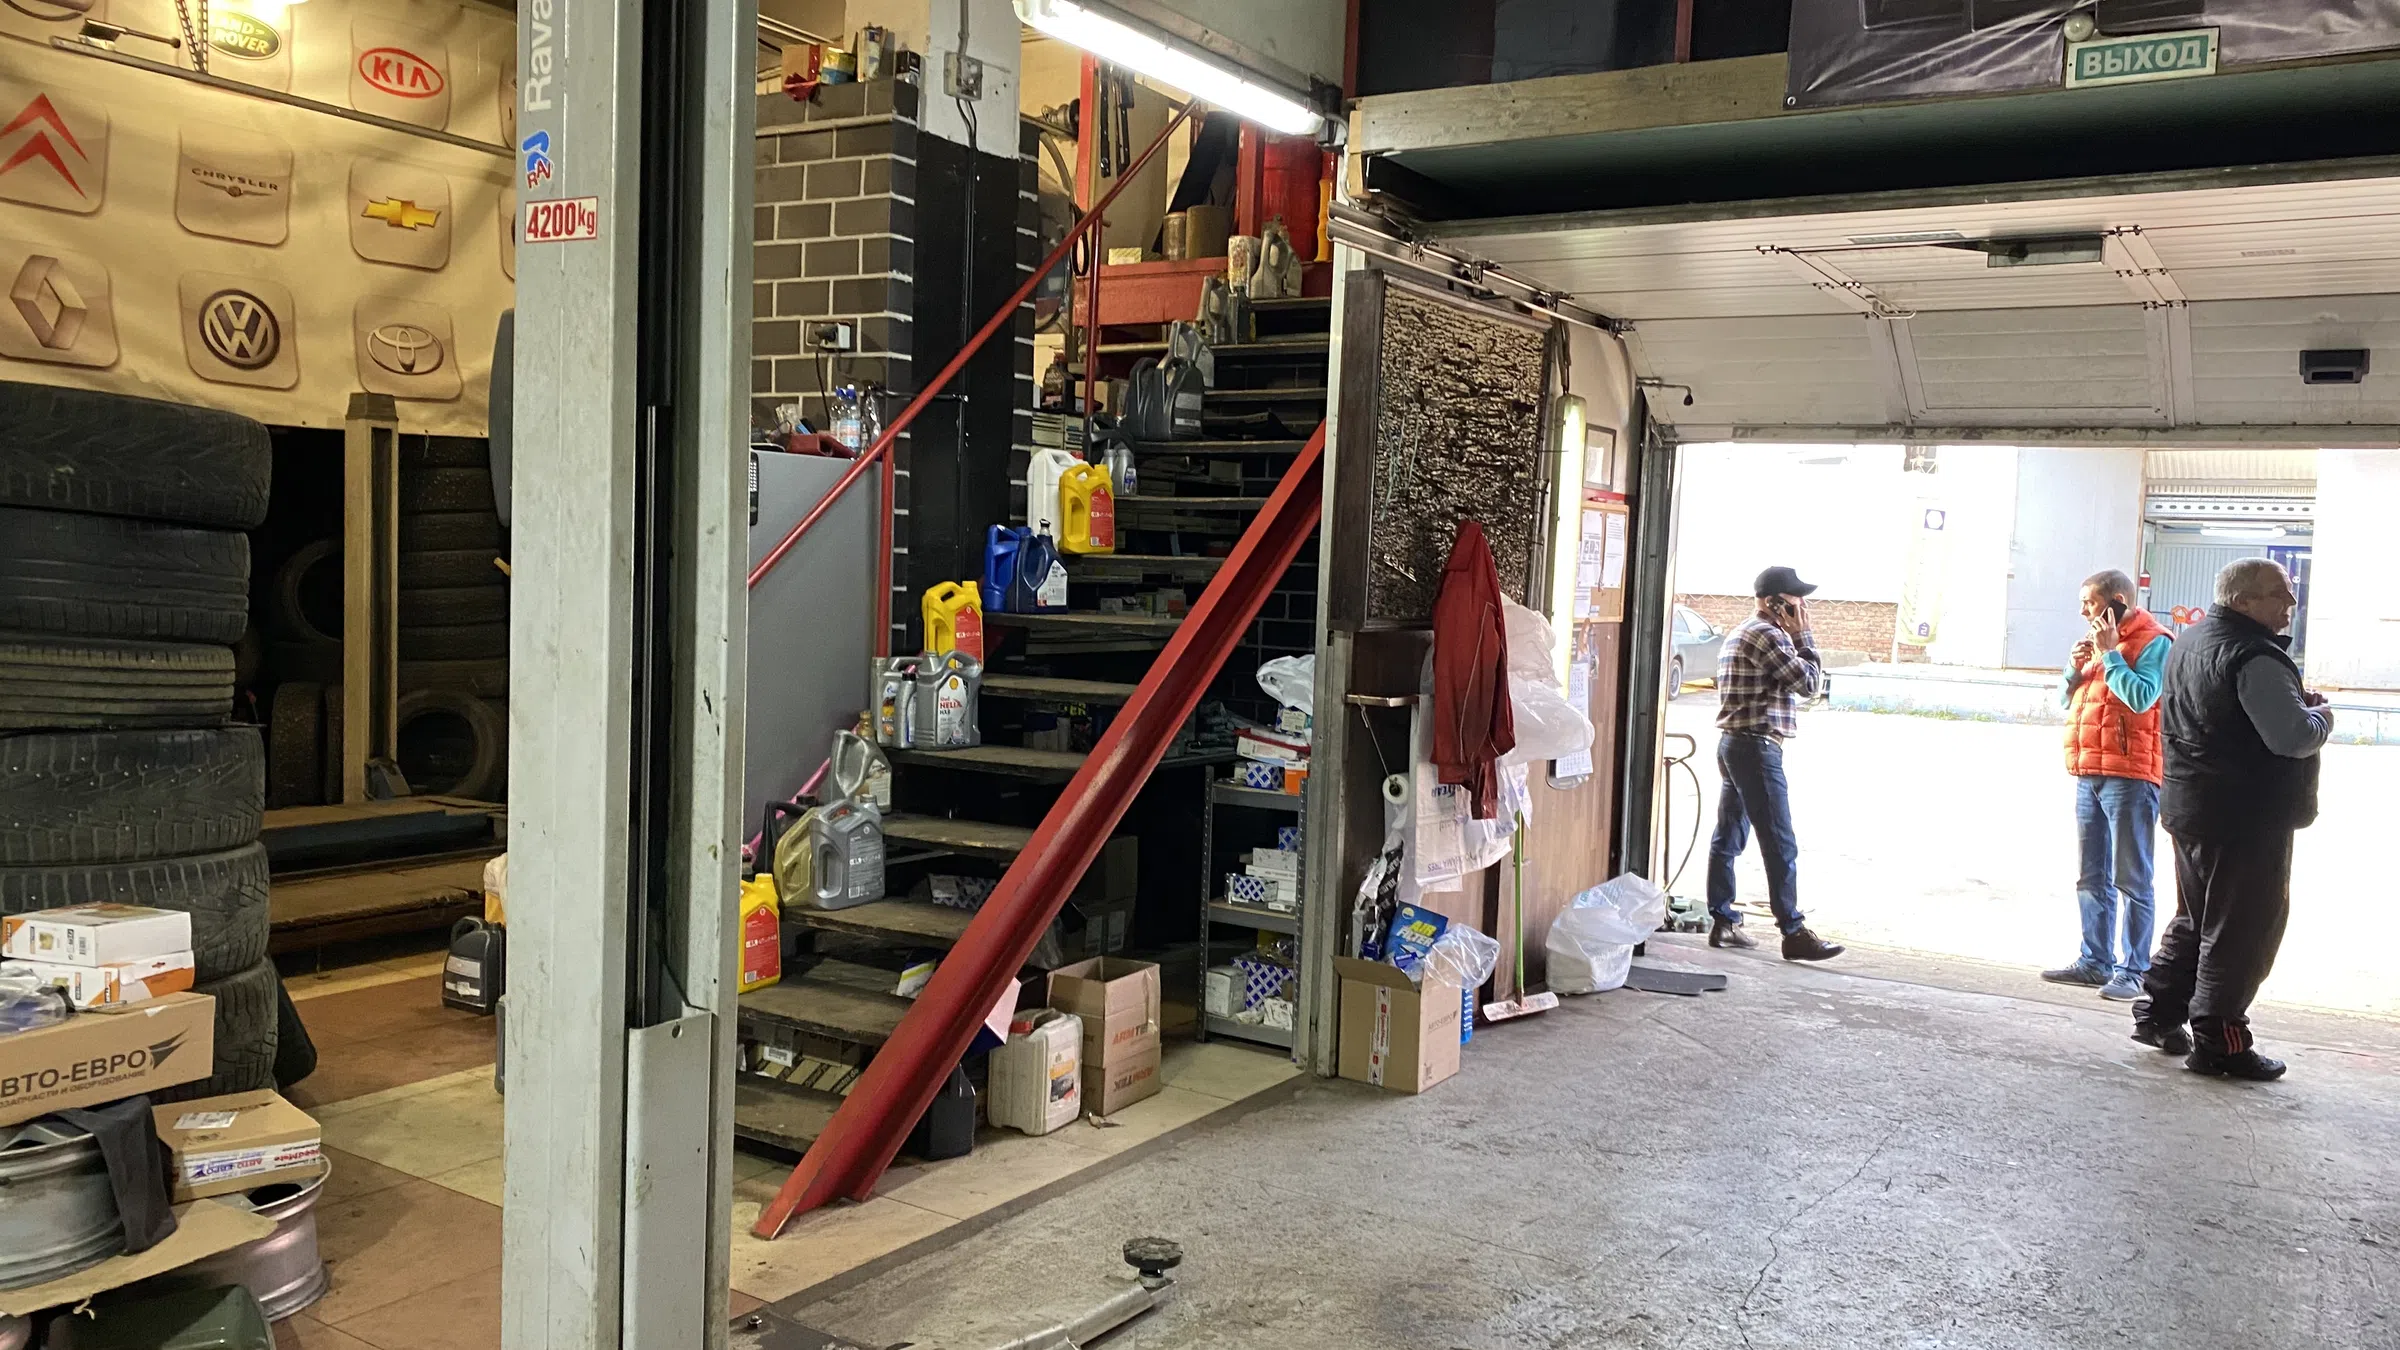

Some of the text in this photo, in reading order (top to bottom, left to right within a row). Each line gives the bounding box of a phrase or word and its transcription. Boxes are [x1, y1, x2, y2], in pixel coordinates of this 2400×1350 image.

[214, 28, 270, 54] ROVER
[2083, 39, 2201, 77] ВЫХОД
[373, 55, 431, 91] KIA
[192, 168, 278, 190] CHRYSLER
[940, 700, 962, 709] HELIX
[1396, 926, 1434, 947] FILTER
[1409, 920, 1437, 937] AIR
[0, 1049, 146, 1098] ВТО-ЕВРО
